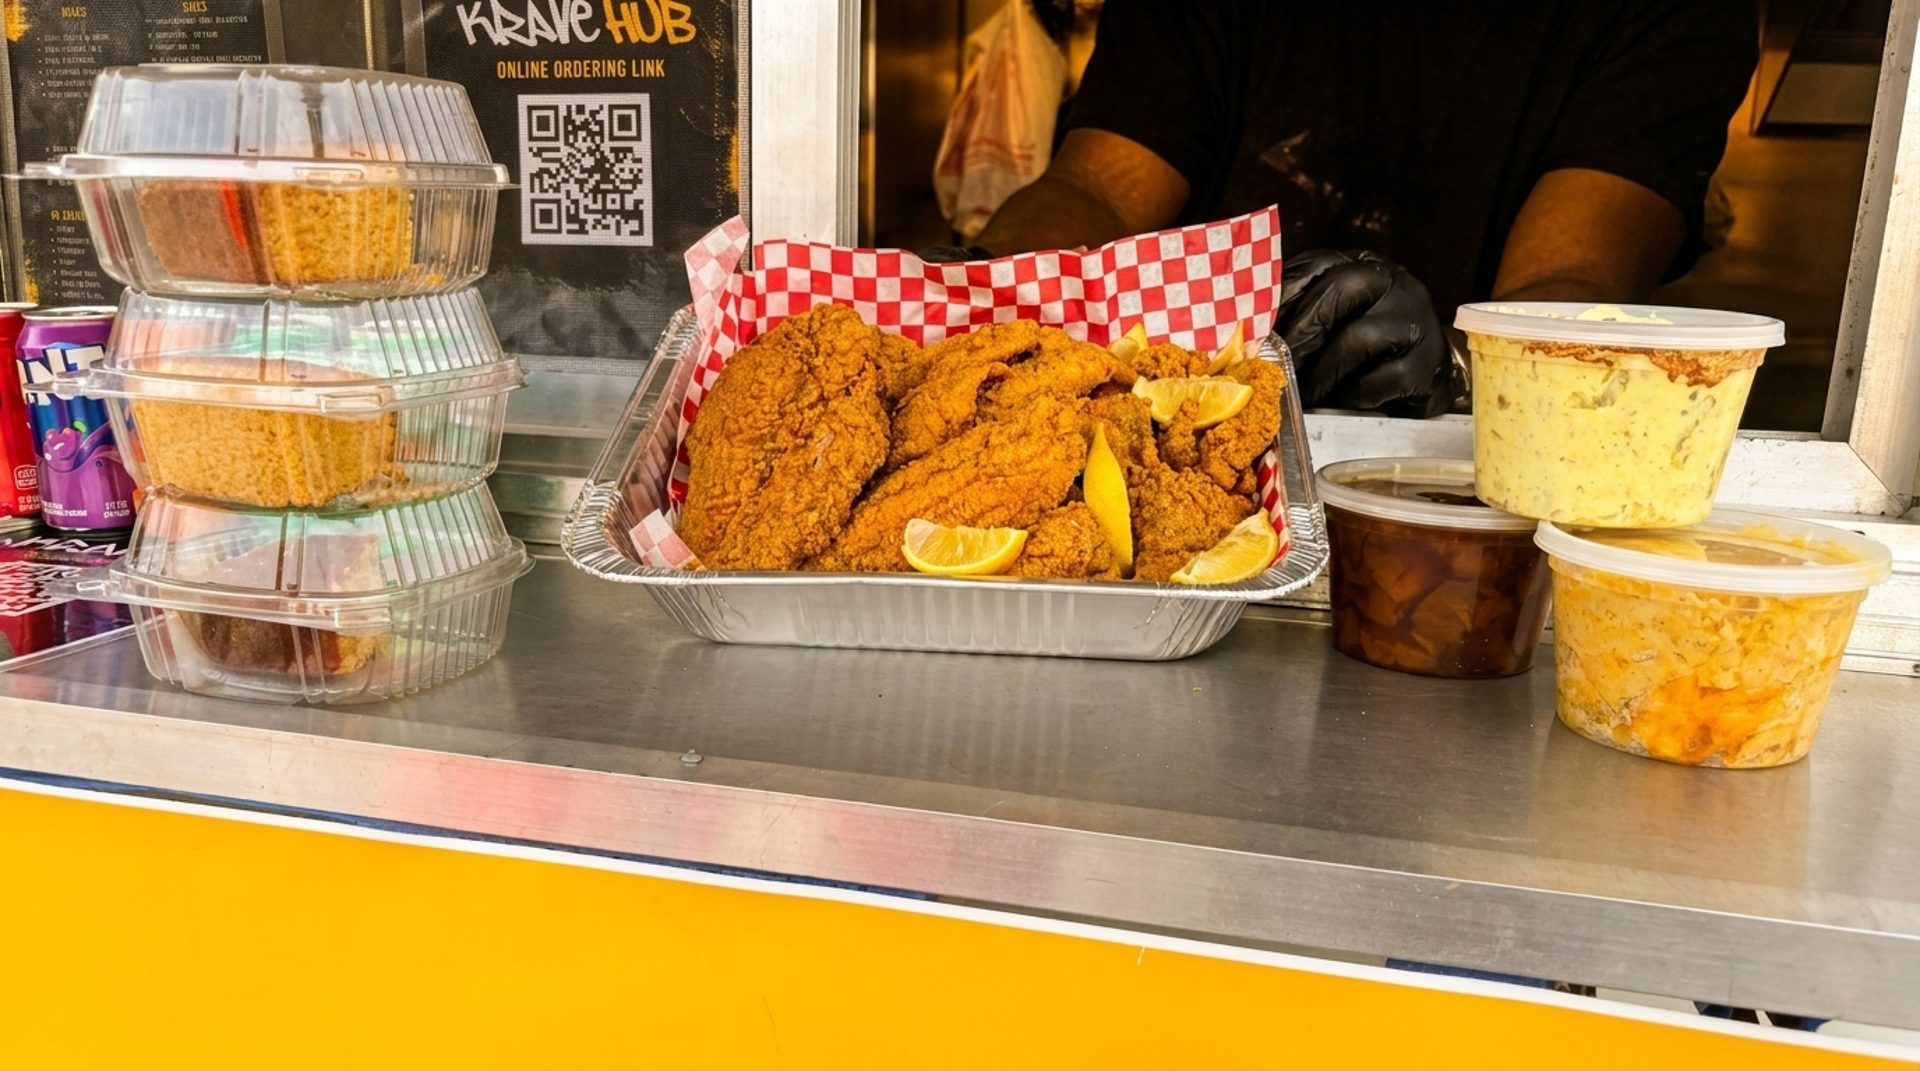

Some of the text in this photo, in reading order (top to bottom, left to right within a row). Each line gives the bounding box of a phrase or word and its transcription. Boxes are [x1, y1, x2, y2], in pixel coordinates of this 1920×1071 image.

[602, 0, 697, 45] HUB
[497, 58, 666, 79] ONLINE ORDERING LINK
